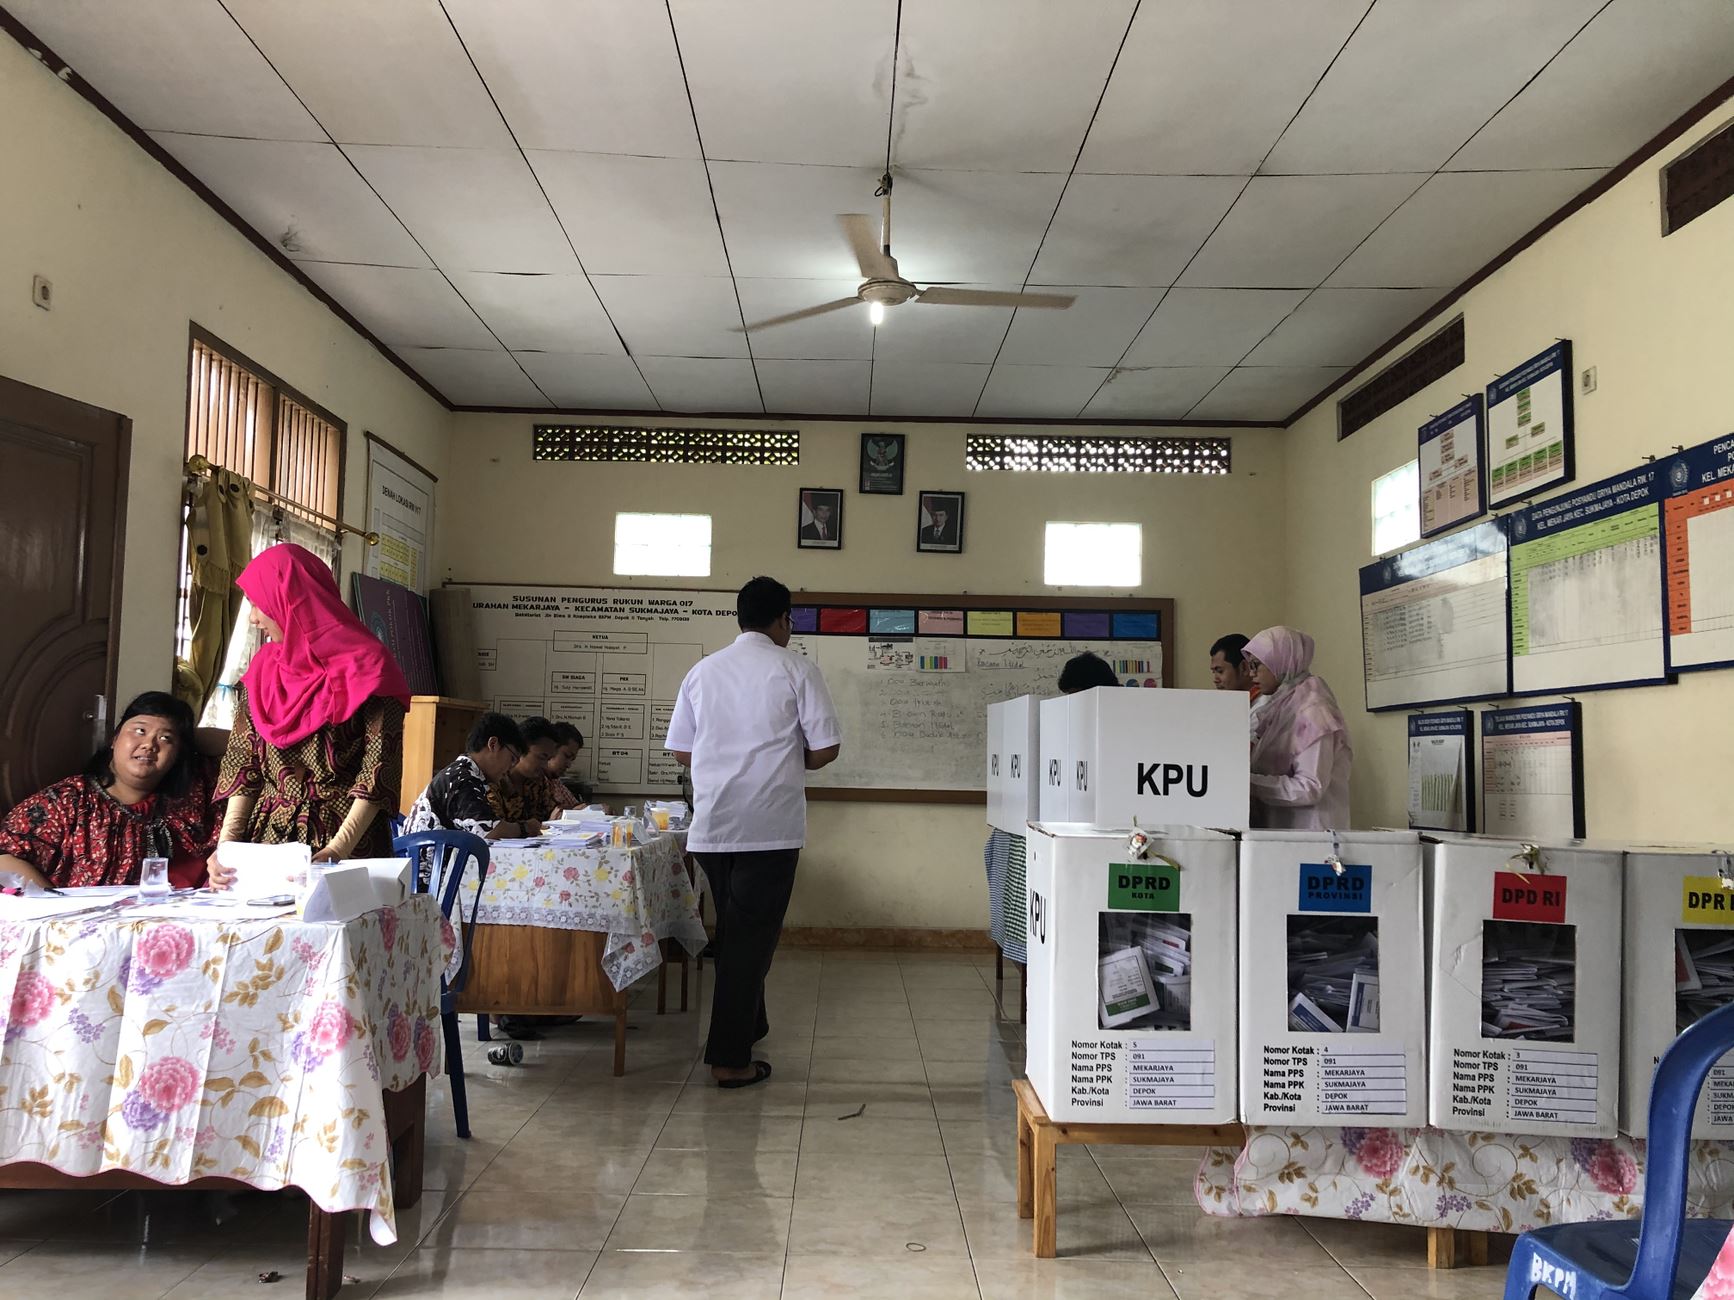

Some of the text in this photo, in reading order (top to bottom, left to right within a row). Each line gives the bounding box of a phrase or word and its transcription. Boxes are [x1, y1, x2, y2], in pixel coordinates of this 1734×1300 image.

[512, 595, 556, 603] SUSUNAN
[561, 597, 608, 605] PENGURUS
[613, 598, 643, 606] RUKUN
[472, 602, 509, 610] URAHAN
[511, 603, 560, 611] MEKARJAYA
[574, 605, 625, 613] KECAMATAN
[629, 607, 679, 615] SUKMAJAYA
[991, 753, 1000, 777] KPU
[1010, 753, 1021, 779] KPU
[1049, 759, 1062, 787] KPU
[1076, 760, 1088, 791] KPU
[1137, 762, 1208, 797] KPU
[1118, 875, 1171, 890] DPRD
[1308, 876, 1364, 891] DPRD
[1308, 892, 1362, 900] PROVINSI
[1502, 887, 1560, 907] DPD RI
[1688, 892, 1725, 910] DPR
[1030, 889, 1046, 944] KPU
[1071, 1041, 1098, 1049] Nomor
[1100, 1041, 1122, 1049] Kotak
[1263, 1045, 1290, 1054] Nomor
[1292, 1046, 1314, 1055] Kotak
[1071, 1052, 1098, 1060] Nomor
[1100, 1052, 1116, 1060] TPS
[1453, 1049, 1480, 1058] Nomor
[1482, 1050, 1506, 1060] Kotak
[1263, 1057, 1290, 1065] Nomor
[1292, 1057, 1308, 1066] TPS
[1453, 1060, 1480, 1069] Nomor
[1482, 1062, 1499, 1071] TPS
[1071, 1063, 1094, 1072] Nama
[1096, 1064, 1112, 1072] PPS
[1263, 1069, 1286, 1077] Nama
[1288, 1069, 1304, 1077] PPS
[1071, 1075, 1094, 1083] Nama
[1096, 1075, 1112, 1083] PPK
[1453, 1072, 1556, 1084] Nama PPS MEKARJAYA
[1263, 1080, 1286, 1088] Nama
[1288, 1080, 1304, 1089] PPK
[1453, 1083, 1557, 1095] Nama PPK SUKMAJAYA
[1071, 1086, 1109, 1095] Kab./Kota
[1263, 1092, 1302, 1100] Kab./Kota
[1071, 1098, 1103, 1106] Provinsi
[1452, 1095, 1491, 1105] Kab./Kota
[1263, 1103, 1296, 1112] Provinsi
[1452, 1106, 1485, 1117] Provinsi
[1536, 1111, 1558, 1119] BARAT
[1530, 1252, 1577, 1300] BKPM
